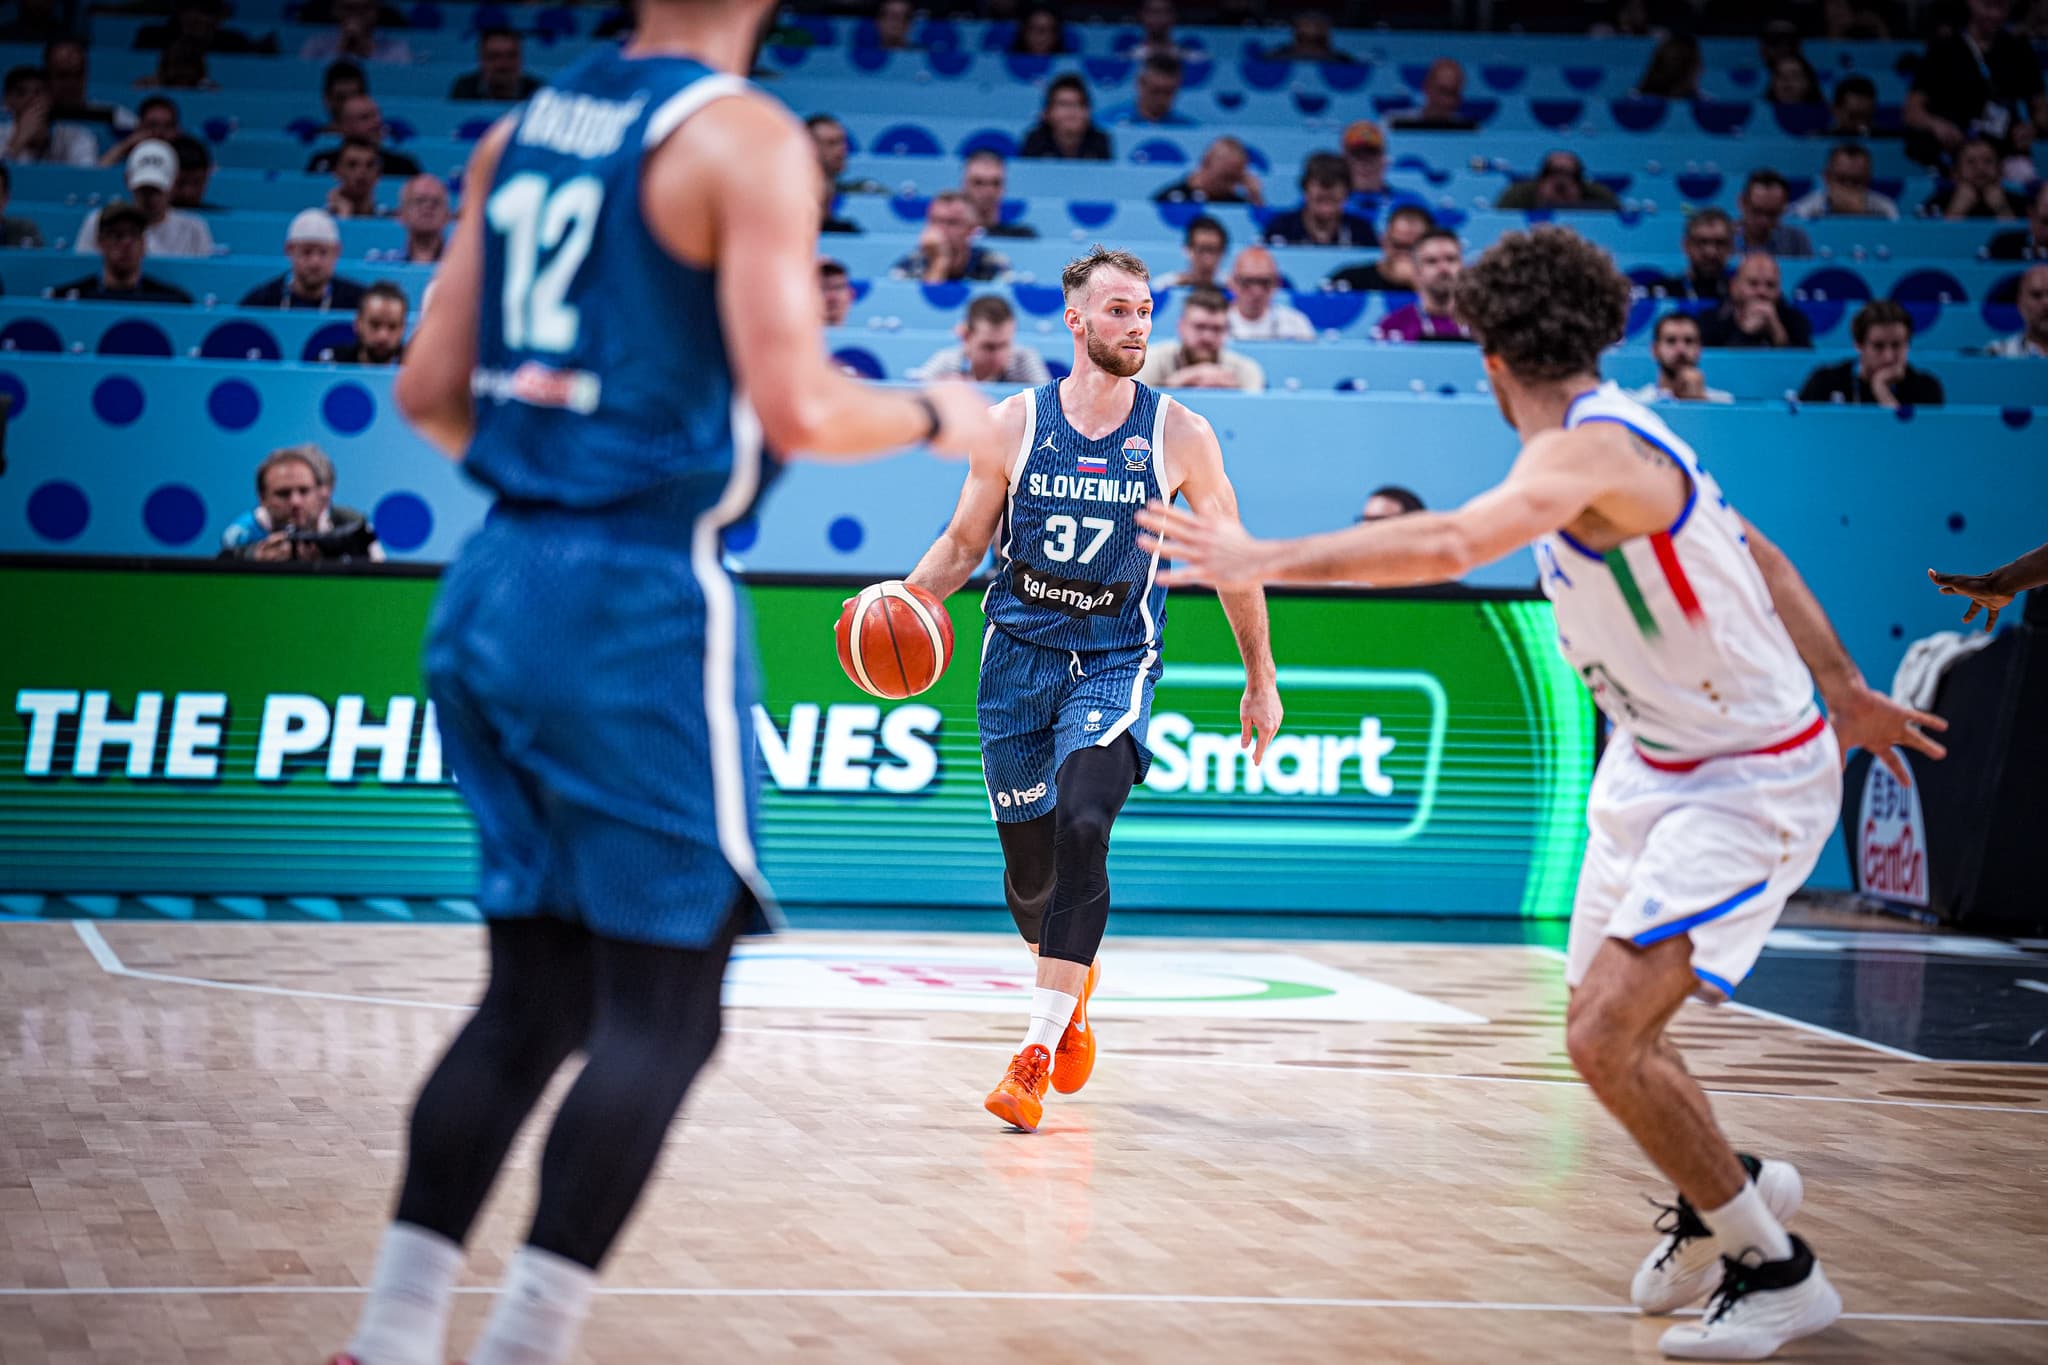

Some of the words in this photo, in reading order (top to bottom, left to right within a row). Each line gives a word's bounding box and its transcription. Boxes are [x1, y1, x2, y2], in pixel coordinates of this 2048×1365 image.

[487, 171, 604, 352] 12
[1029, 472, 1146, 504] SLOVENIJA
[1043, 514, 1115, 564] 37
[16, 689, 228, 779] THE
[1147, 712, 1396, 797] Smart
[1012, 782, 1047, 806] hse
